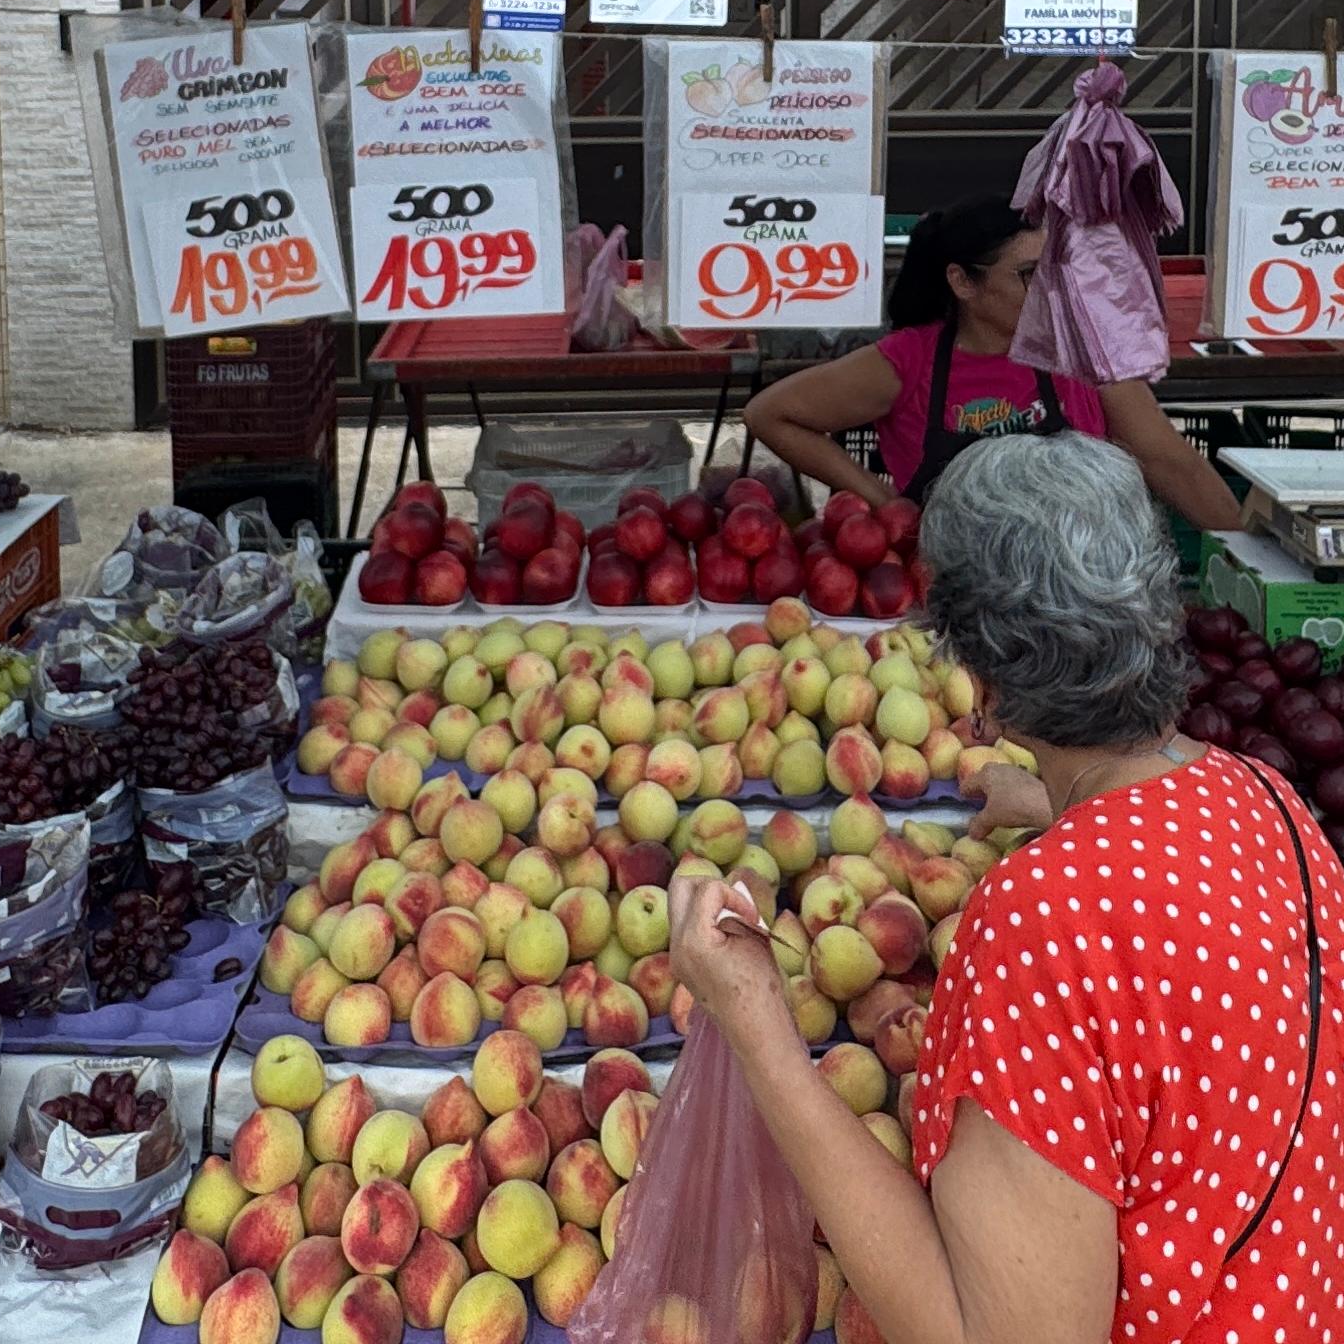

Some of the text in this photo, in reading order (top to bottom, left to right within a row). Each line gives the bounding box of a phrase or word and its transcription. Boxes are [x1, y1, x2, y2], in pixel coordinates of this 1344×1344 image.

[1007, 29, 1135, 46] 3232.1954
[178, 67, 288, 101] CRIMSON
[420, 83, 526, 98] BEM DOCE
[205, 94, 280, 114] SEMENTE
[135, 114, 292, 147] SELECIONADAS
[421, 116, 492, 131] MELHOR
[690, 124, 844, 141] SELECIONADOS
[138, 139, 236, 164] PURO MEL
[368, 139, 529, 157] SELECIONADAS
[775, 149, 830, 169] DOCE
[1267, 176, 1319, 189] BEM
[388, 183, 494, 222] 500
[723, 194, 816, 227] 500
[185, 188, 295, 238] 500
[224, 222, 289, 250] GRAMA
[416, 218, 473, 237] GRAMA
[744, 223, 808, 242] GRAMA
[170, 236, 318, 324] 19,99
[362, 229, 537, 311] 19,99
[698, 241, 859, 320] 9,99
[219, 363, 269, 382] FRUTAS
